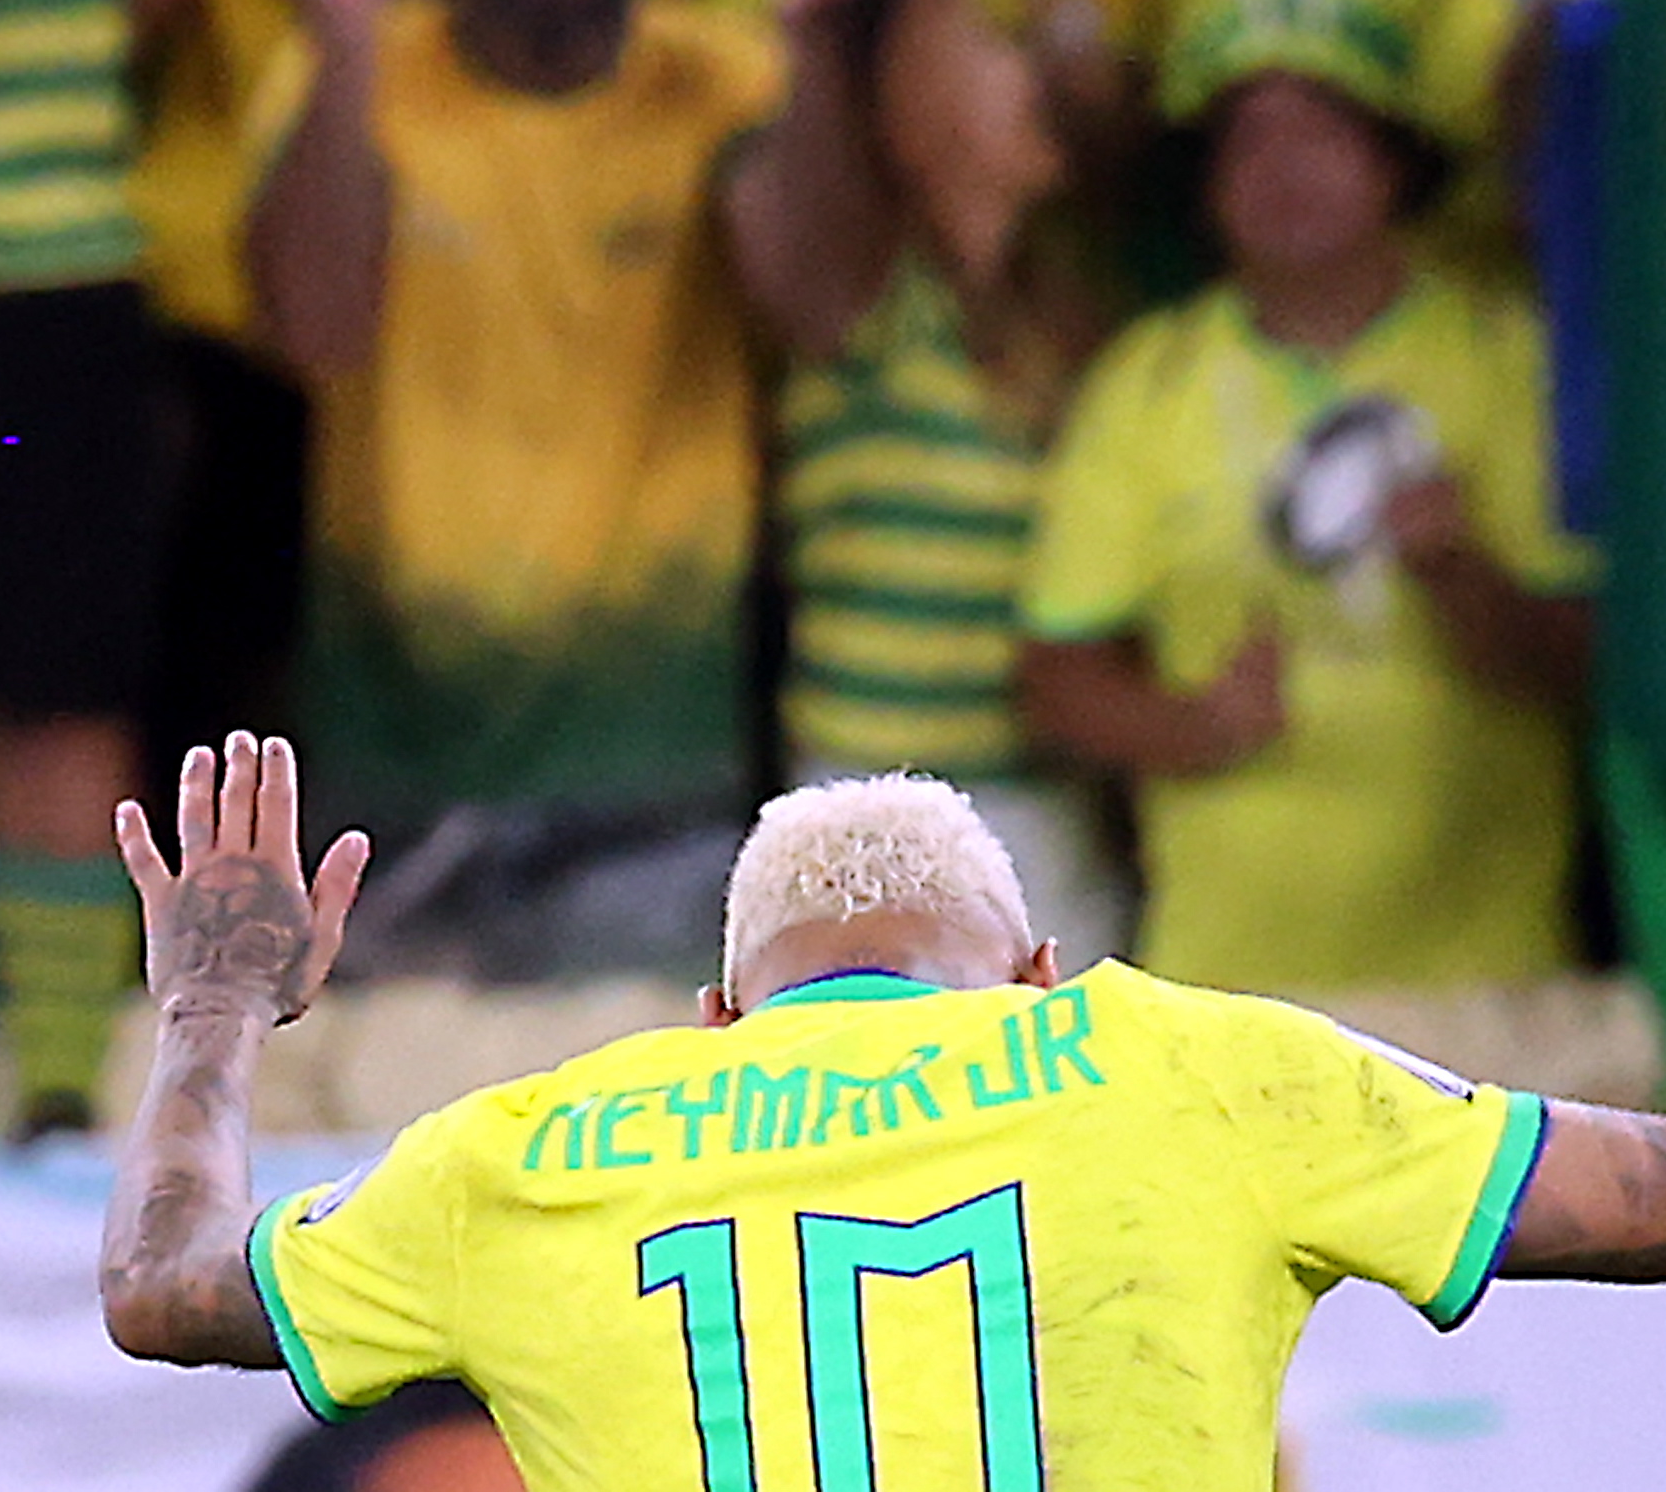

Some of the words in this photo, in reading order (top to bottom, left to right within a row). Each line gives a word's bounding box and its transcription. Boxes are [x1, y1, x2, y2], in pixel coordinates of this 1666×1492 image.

[523, 1044, 942, 1171] NEYMAR
[966, 986, 1107, 1110] JR
[636, 1180, 1046, 1492] 10
